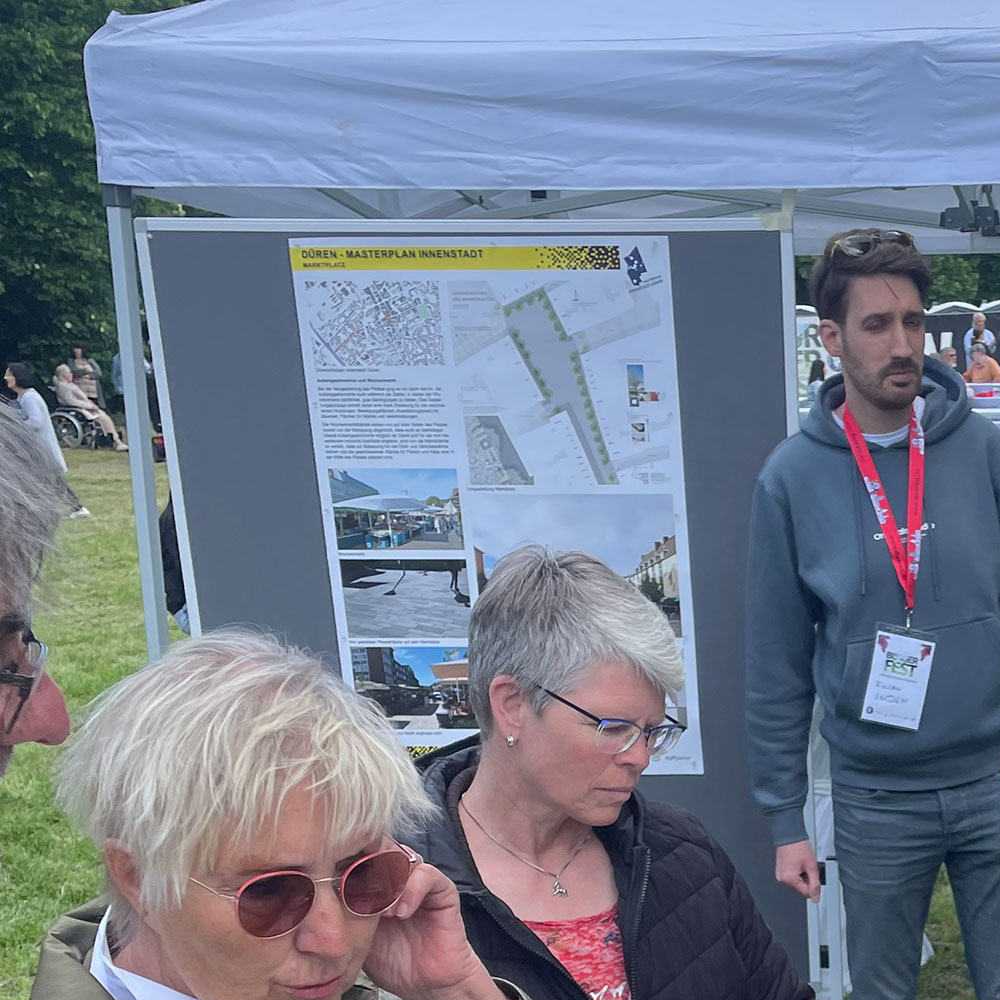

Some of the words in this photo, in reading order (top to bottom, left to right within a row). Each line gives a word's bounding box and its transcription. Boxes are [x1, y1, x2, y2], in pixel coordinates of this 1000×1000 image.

[301, 248, 337, 259] DÜREN
[345, 249, 416, 259] MASTERPLAN
[418, 249, 484, 259] INNENSTADT
[884, 659, 918, 677] FEST
